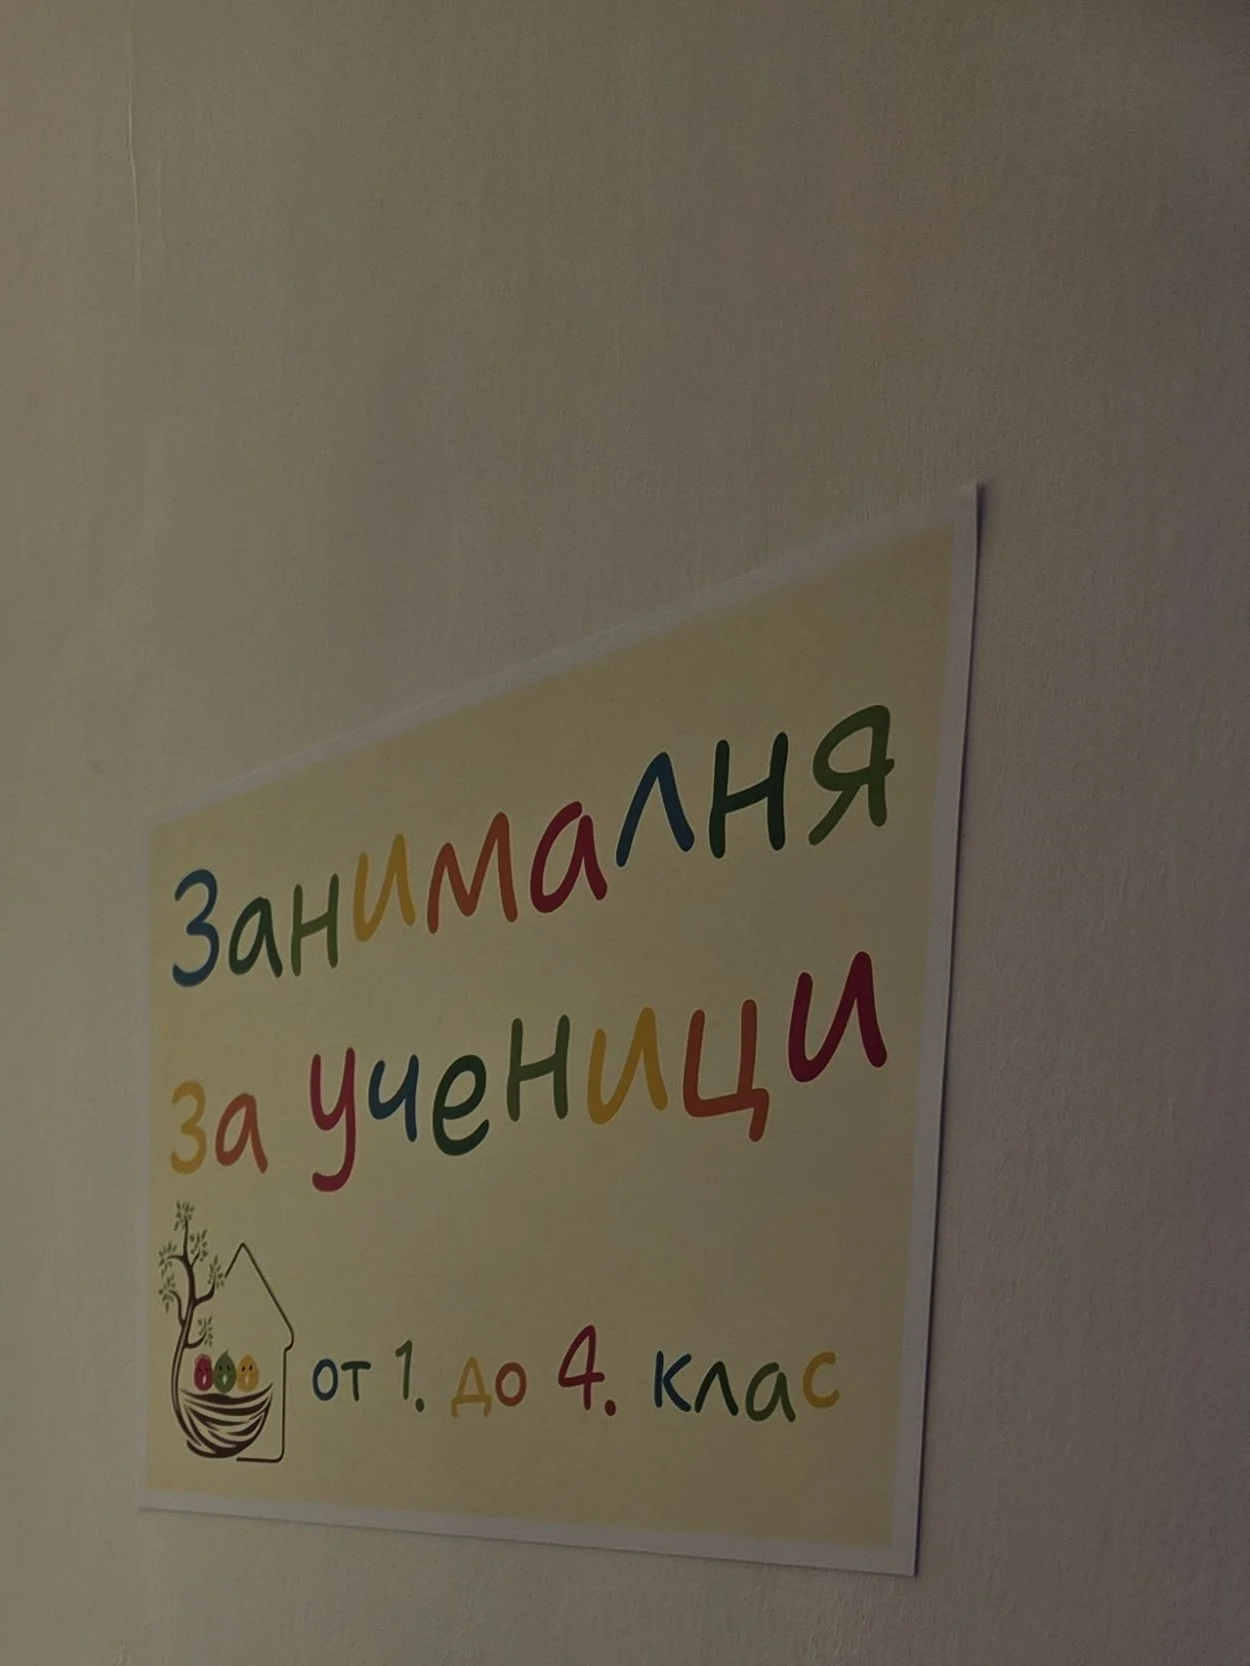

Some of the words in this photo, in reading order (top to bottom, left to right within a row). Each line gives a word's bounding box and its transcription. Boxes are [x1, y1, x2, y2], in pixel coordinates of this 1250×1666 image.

[171, 704, 896, 988] Занималня
[169, 1079, 270, 1176] за
[309, 950, 888, 1193] ученици
[309, 1357, 372, 1403] от
[393, 1338, 426, 1413] 1.
[449, 1355, 529, 1420] до
[556, 1324, 618, 1417] 4.
[652, 1350, 841, 1424] клас
